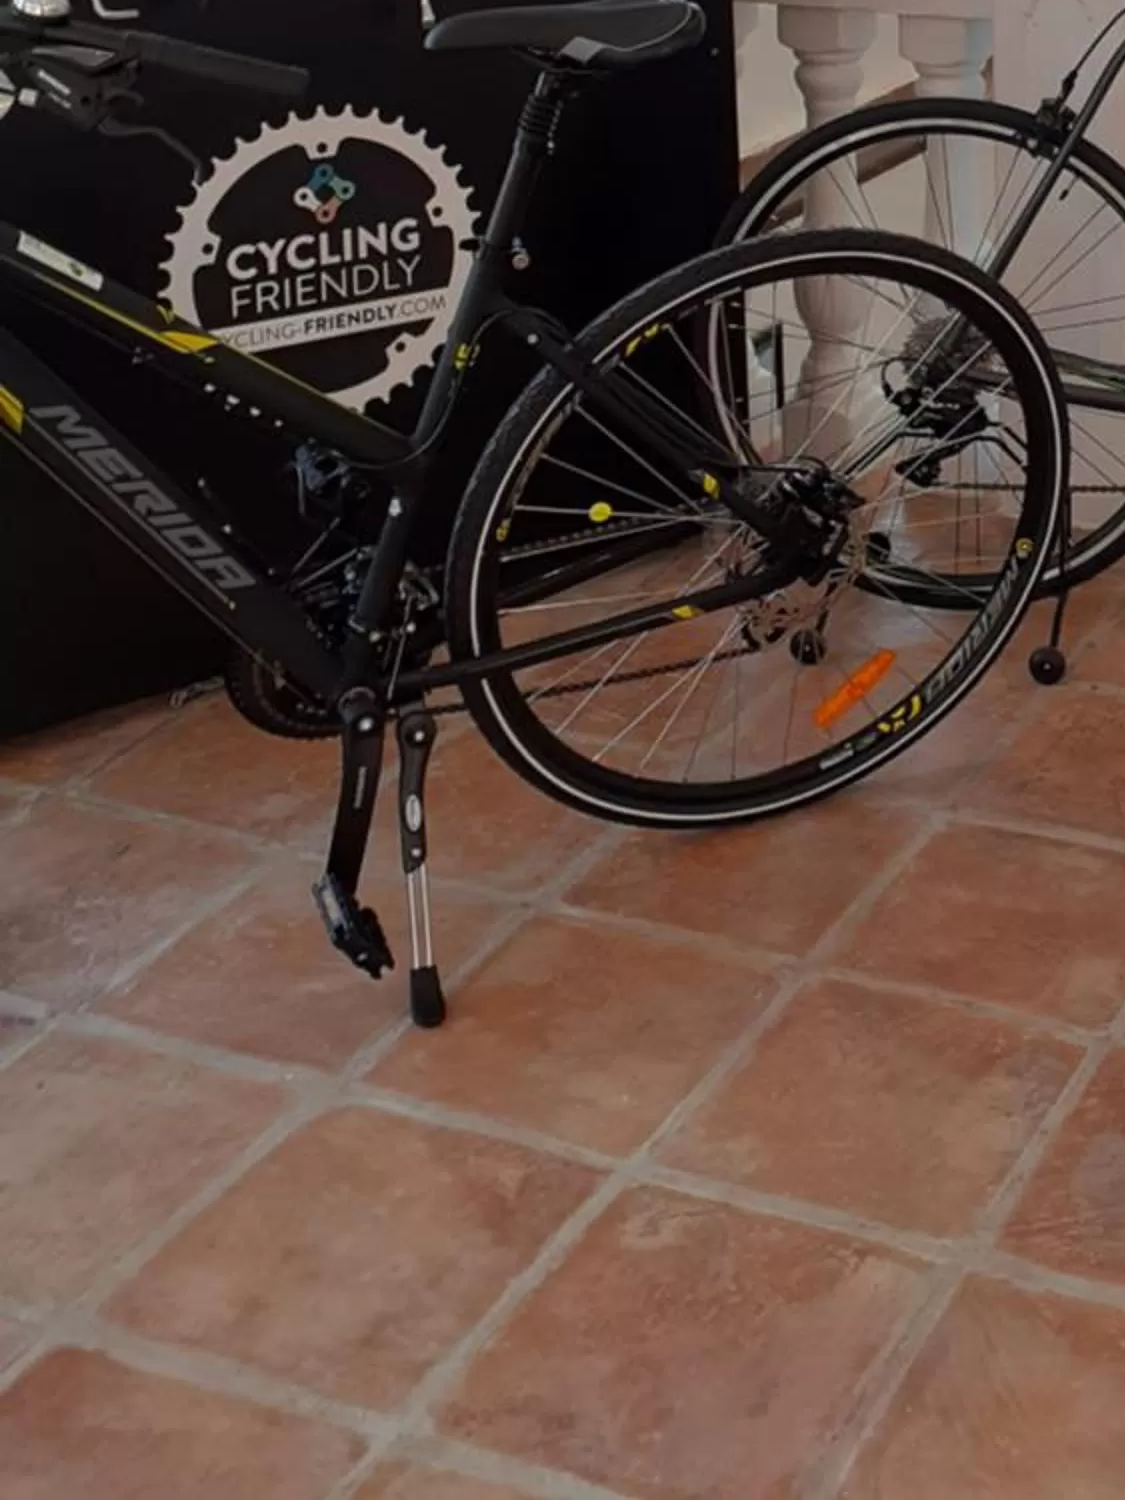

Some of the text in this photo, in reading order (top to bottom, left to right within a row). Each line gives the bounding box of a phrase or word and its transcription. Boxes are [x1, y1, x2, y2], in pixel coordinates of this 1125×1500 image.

[225, 218, 421, 281] CYCLING
[230, 255, 422, 318] FRIENDLY
[222, 294, 448, 350] YCLING-FRIENDLY.COM
[29, 404, 257, 590] MERIDA
